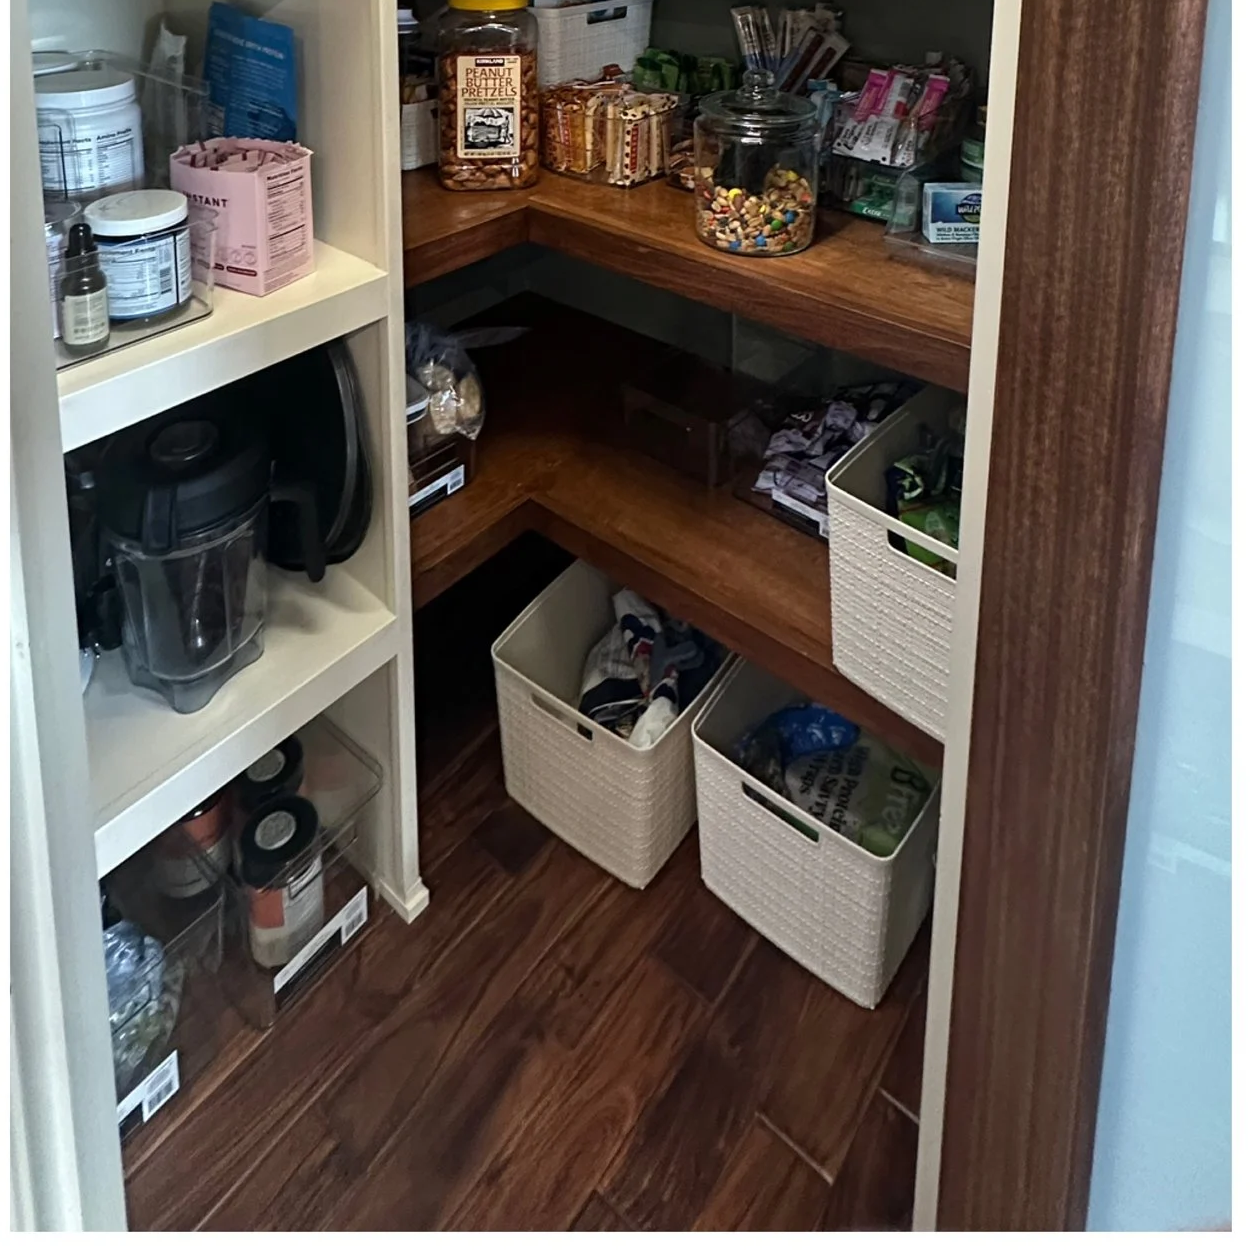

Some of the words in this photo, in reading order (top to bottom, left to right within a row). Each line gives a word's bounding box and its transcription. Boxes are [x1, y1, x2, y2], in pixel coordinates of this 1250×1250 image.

[465, 68, 513, 77] PEANUT
[466, 78, 513, 87] BUTTER
[462, 87, 517, 97] PRETZELS
